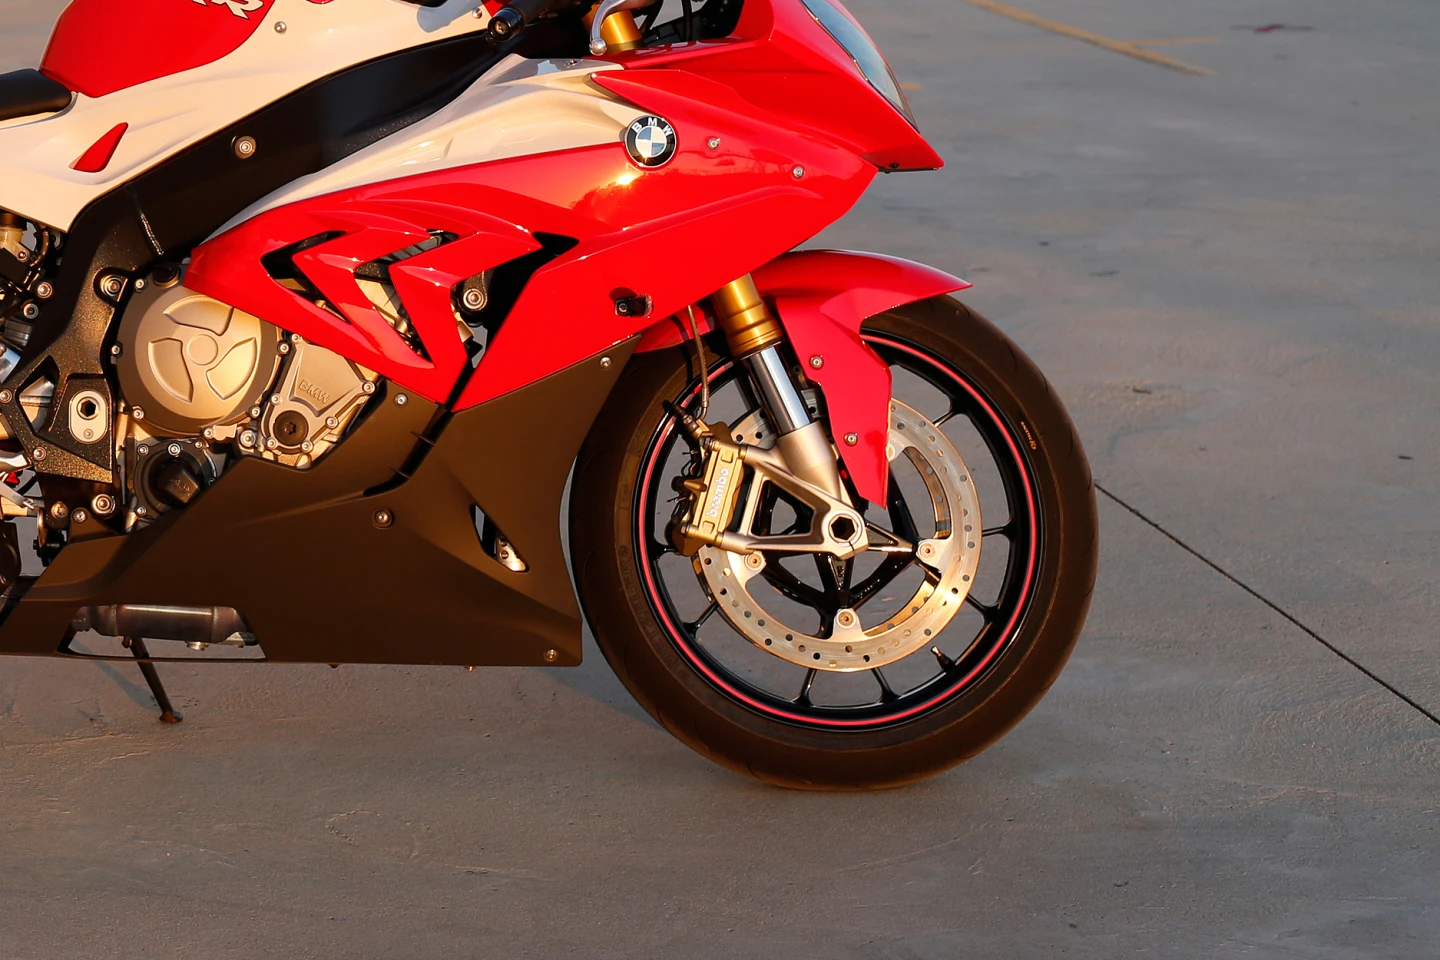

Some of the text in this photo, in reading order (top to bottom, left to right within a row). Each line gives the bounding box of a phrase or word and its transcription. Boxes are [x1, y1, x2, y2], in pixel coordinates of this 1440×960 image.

[631, 117, 673, 137] BMW
[299, 379, 331, 404] BMW
[705, 468, 729, 518] brembo
